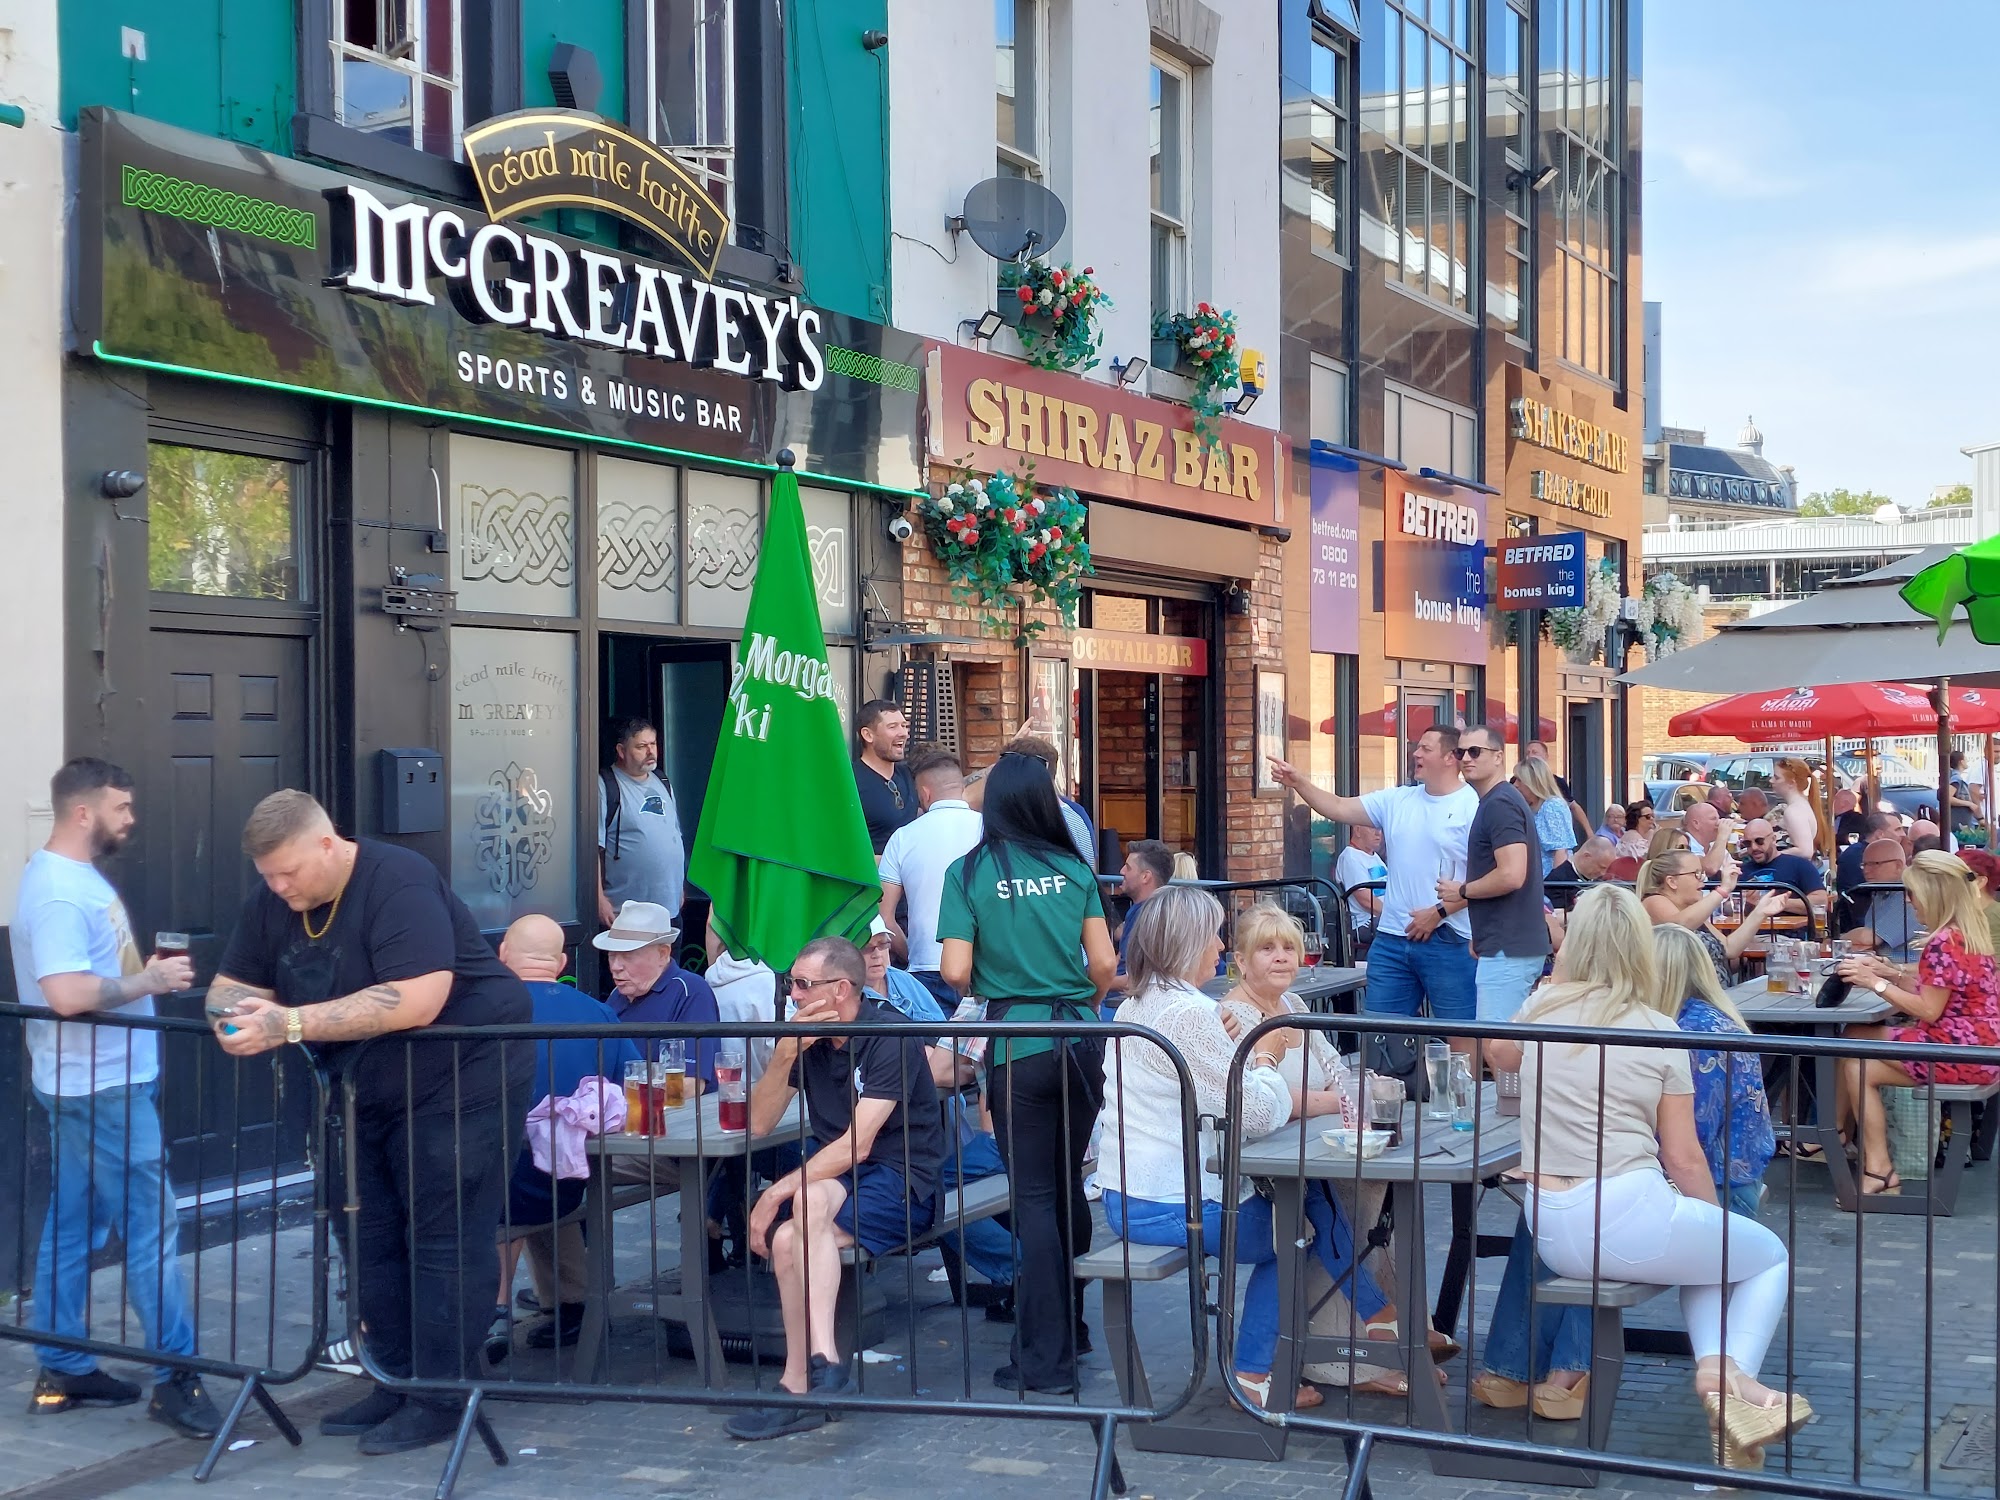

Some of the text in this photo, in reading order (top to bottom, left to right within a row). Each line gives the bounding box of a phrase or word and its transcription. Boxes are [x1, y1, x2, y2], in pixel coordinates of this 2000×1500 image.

[346, 185, 826, 393] McGREAVEY'S
[456, 350, 743, 434] SPORTS & MUSIC BAR
[967, 377, 1262, 502] SHIRAZ BAR
[1523, 397, 1629, 474] SHAKESPEARE
[1544, 469, 1613, 518] BAR & GRILL
[1312, 518, 1357, 541] betfred.com
[1402, 491, 1479, 546] BETFRED
[1321, 544, 1348, 564] 0800
[1504, 544, 1575, 565] BETFRED
[1312, 567, 1357, 589] 73 11 210
[1466, 566, 1481, 594] the
[1504, 583, 1575, 598] bonus king
[1558, 568, 1575, 581] the
[1414, 590, 1481, 632] bonus king
[745, 632, 834, 701] Morga
[1072, 635, 1193, 668] OCKTAIL BAR
[734, 693, 771, 742] ki
[996, 874, 1067, 900] STAFF
